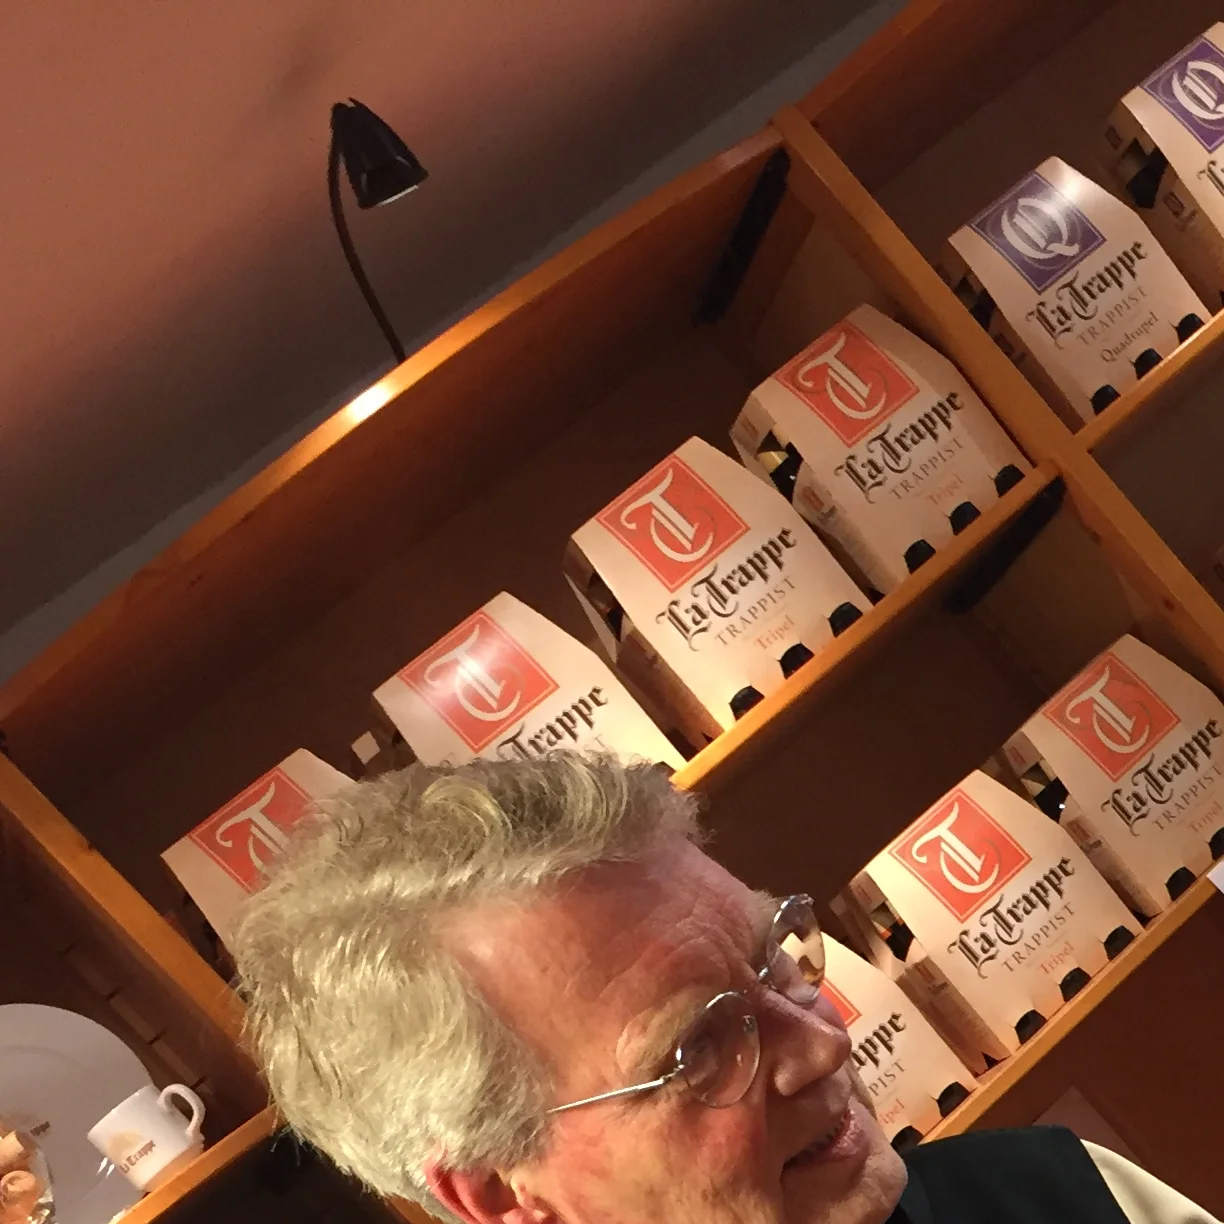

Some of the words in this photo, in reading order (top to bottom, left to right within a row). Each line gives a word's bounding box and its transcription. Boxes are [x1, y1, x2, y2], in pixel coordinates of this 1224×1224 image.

[1000, 197, 1080, 260] Q
[1077, 286, 1148, 346] TRAPPIST
[1101, 311, 1159, 363] Quadrupel
[889, 437, 964, 500] TRAPPIST
[714, 575, 795, 646] TRAPPIST
[754, 615, 796, 650] Tripel
[1152, 763, 1224, 830] TRAPPIST
[1002, 901, 1075, 972] TRAPPIST
[1039, 940, 1075, 974] Tripel
[851, 1011, 906, 1069] appe
[868, 1058, 905, 1096] PIST
[880, 1098, 905, 1124] ipel
